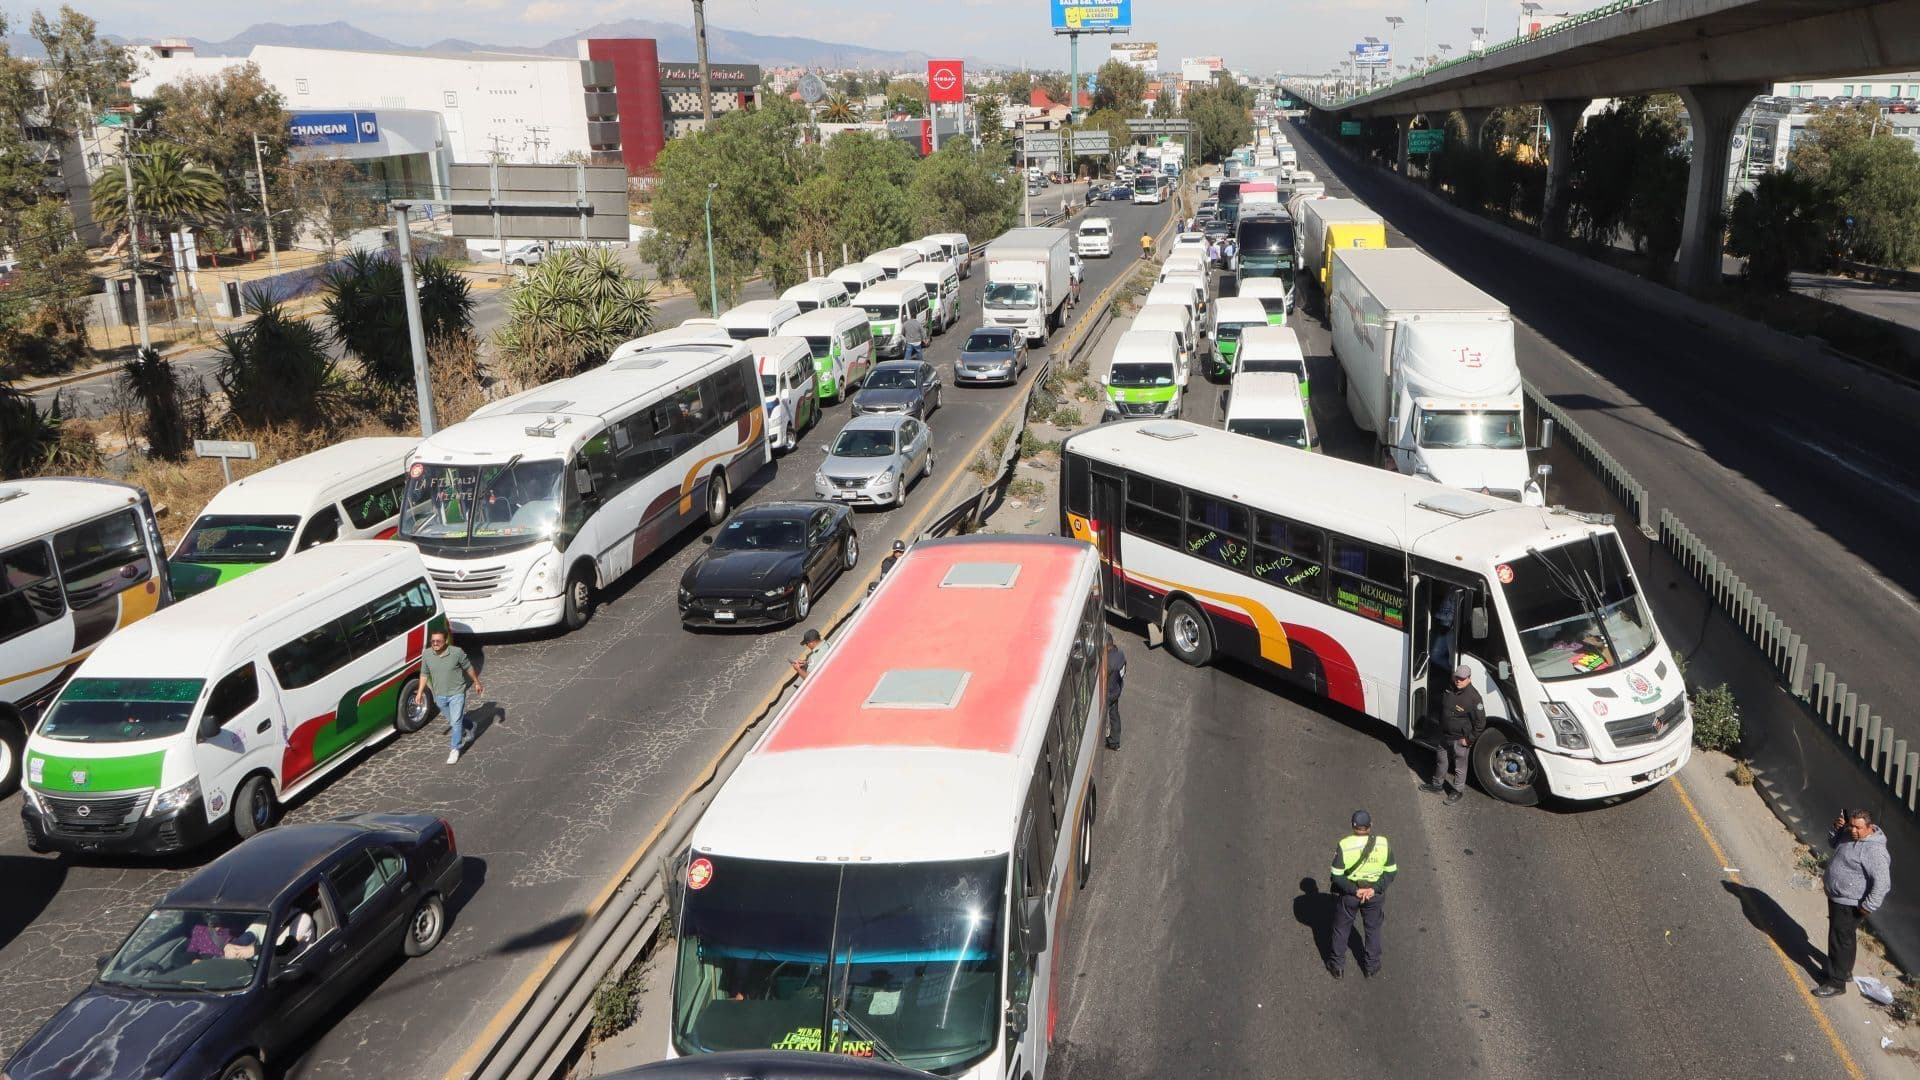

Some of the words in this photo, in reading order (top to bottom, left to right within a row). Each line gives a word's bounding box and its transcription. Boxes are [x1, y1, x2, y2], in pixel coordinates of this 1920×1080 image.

[290, 124, 348, 136] CHANGAN
[414, 479, 427, 490] LA
[1219, 543, 1238, 561] NO
[1255, 555, 1293, 576] DELITOS
